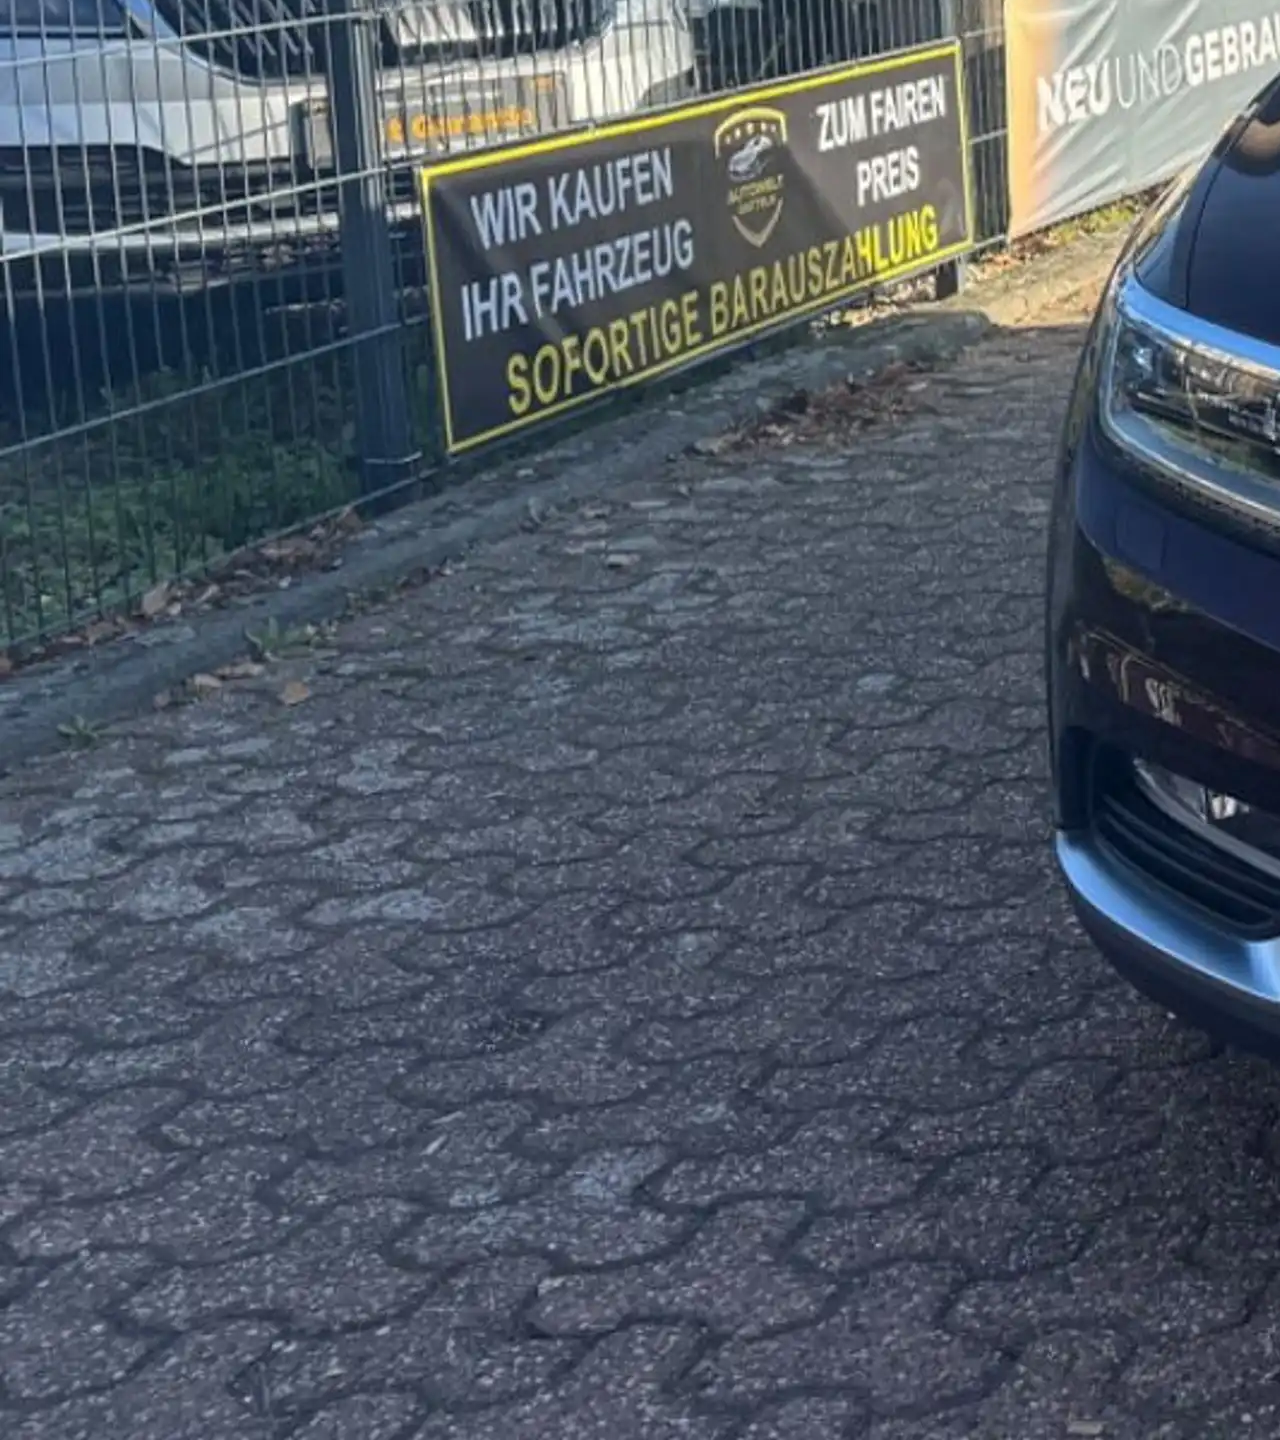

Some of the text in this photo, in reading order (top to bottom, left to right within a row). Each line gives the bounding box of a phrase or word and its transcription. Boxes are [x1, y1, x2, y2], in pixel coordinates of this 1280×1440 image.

[815, 74, 947, 151] ZUM FAIREN
[470, 148, 674, 250] WIR KAUFEN
[856, 146, 921, 208] PREIS
[461, 218, 695, 342] IHR FAHRZEUG
[506, 204, 939, 415] SOFORTIGE BARAUSZAHLUNG
